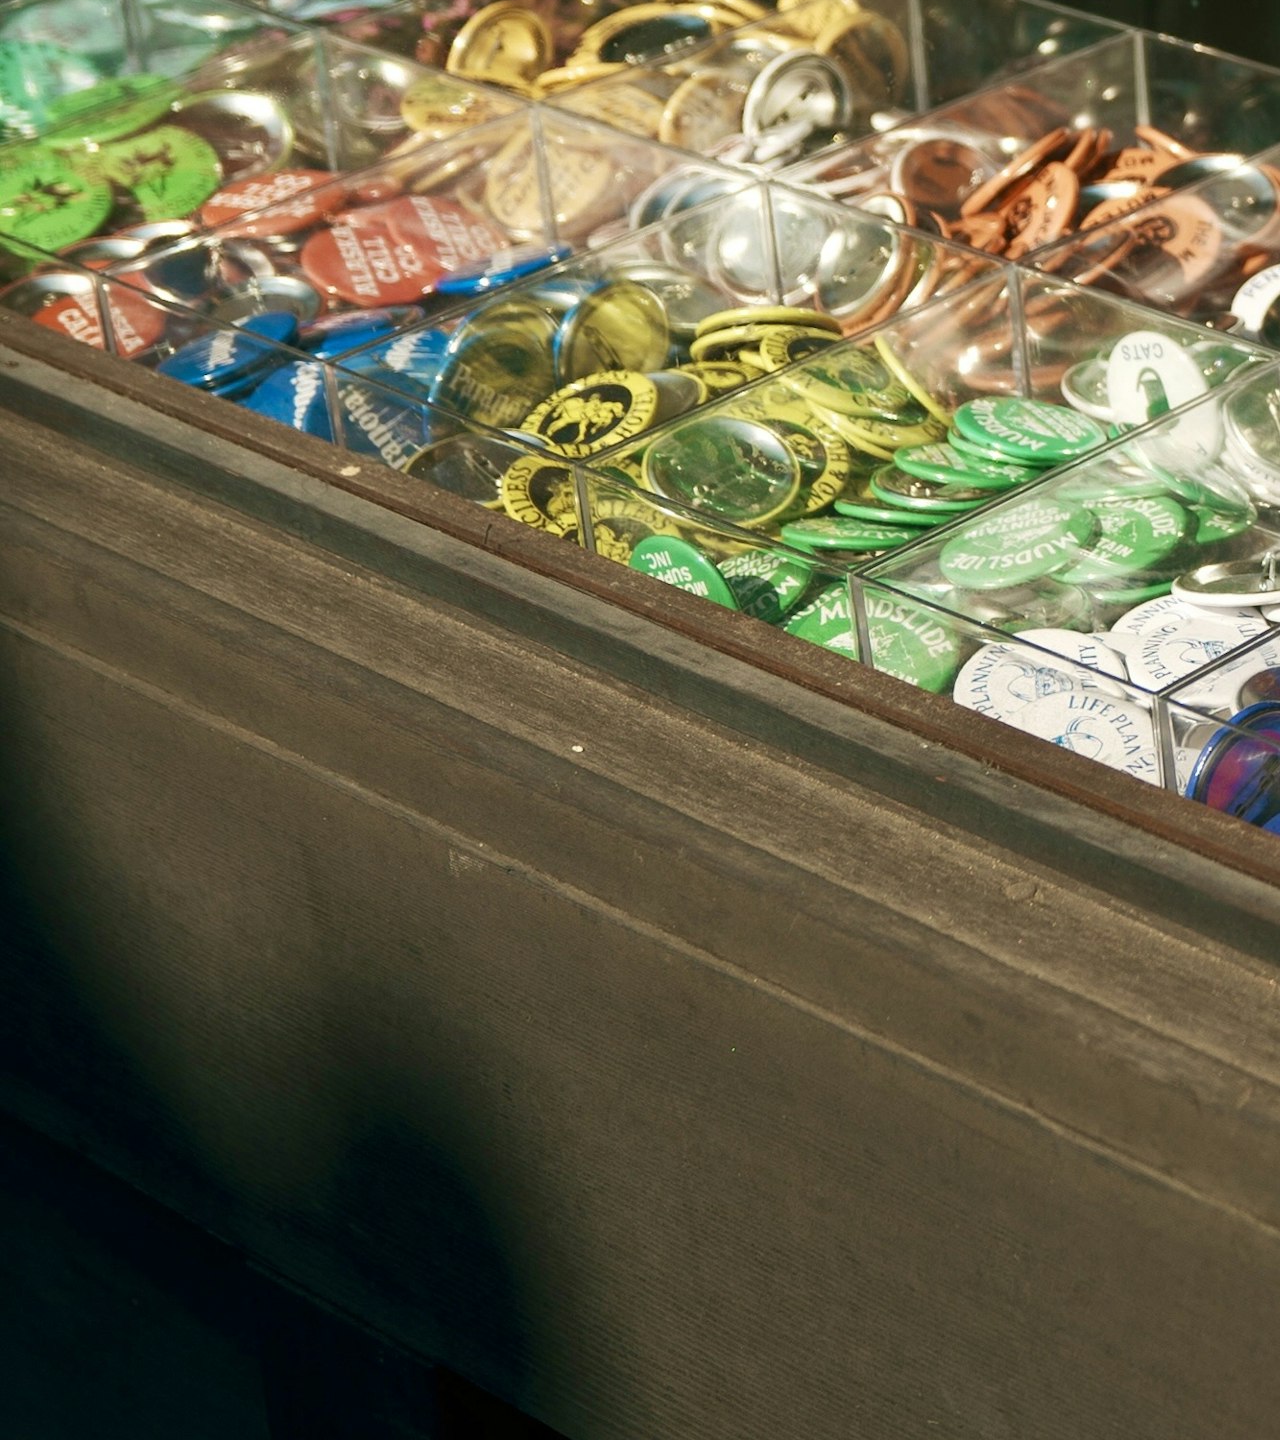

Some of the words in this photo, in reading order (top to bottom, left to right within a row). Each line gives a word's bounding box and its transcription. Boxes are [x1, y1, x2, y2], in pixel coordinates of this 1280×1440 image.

[1120, 341, 1165, 363] CATS
[944, 530, 1081, 569] MUDSLIDE
[1068, 694, 1115, 717] LIFE
